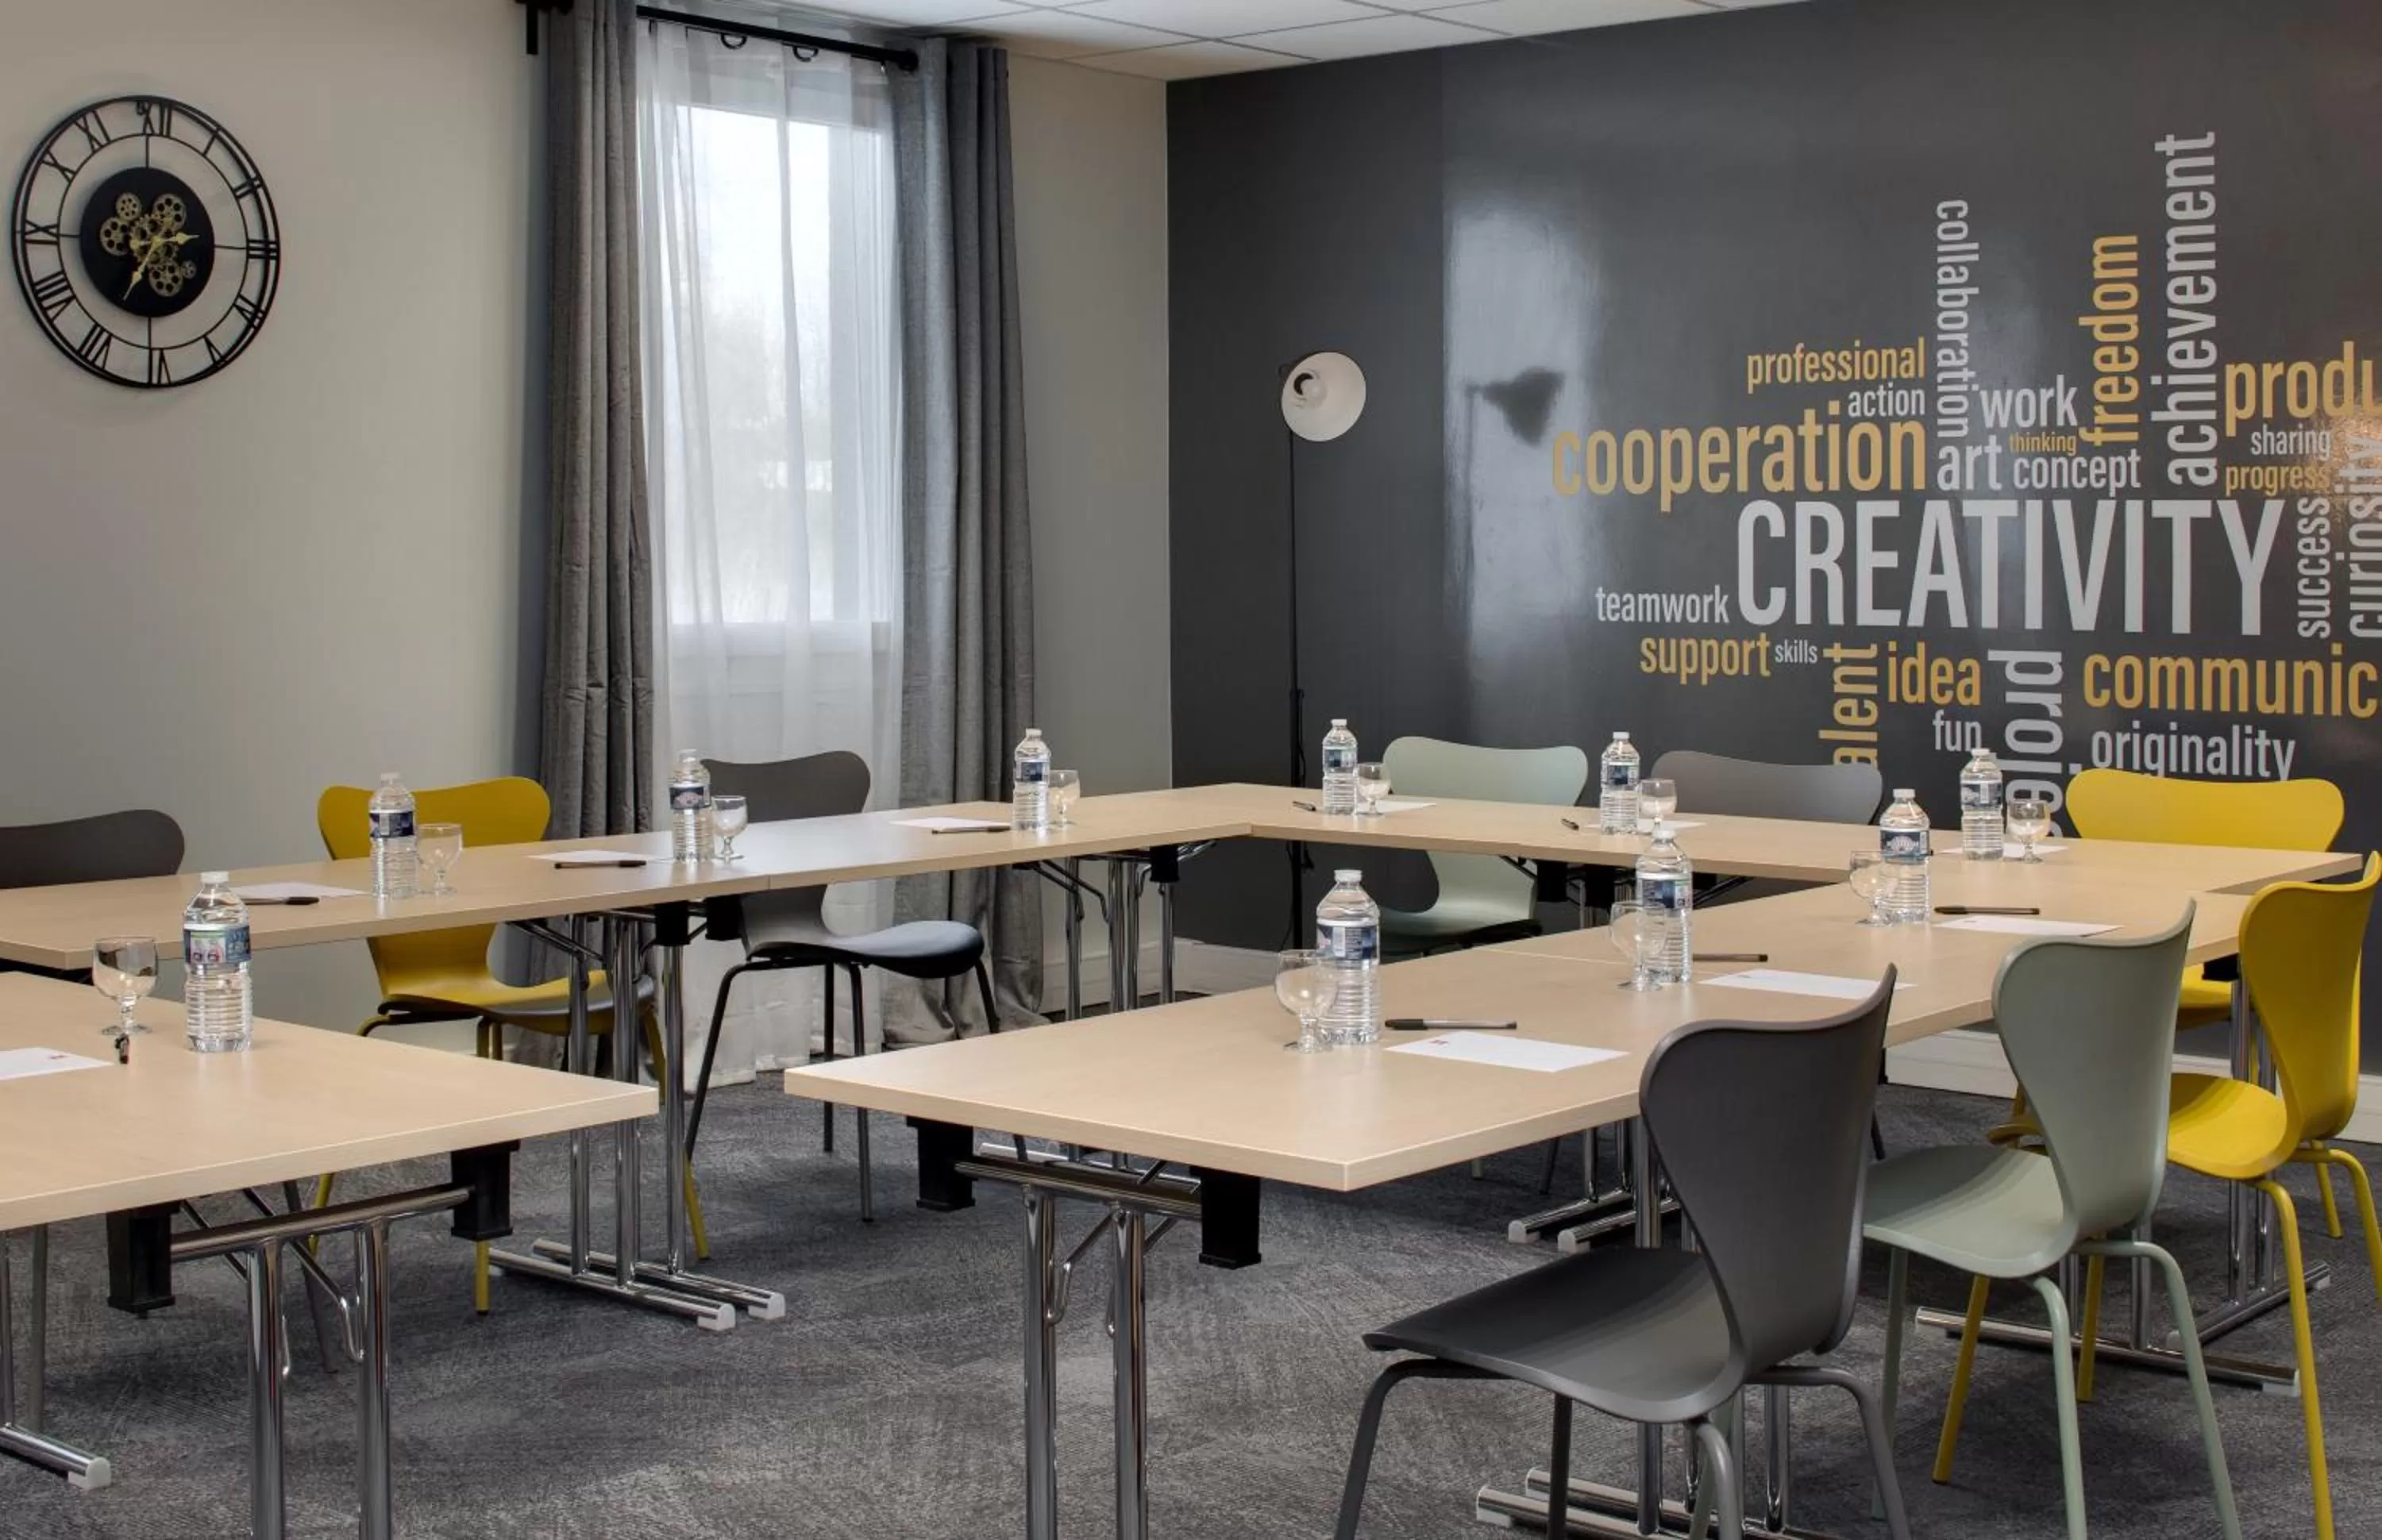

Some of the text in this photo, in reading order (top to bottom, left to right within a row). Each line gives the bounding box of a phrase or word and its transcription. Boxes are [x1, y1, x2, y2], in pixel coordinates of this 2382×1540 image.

[1937, 199, 1979, 438] collaboration
[2151, 131, 2218, 486] achievement
[1748, 337, 1925, 394] professional
[2079, 235, 2139, 445] freedom
[1848, 383, 1925, 417] action
[1980, 375, 2078, 429] work
[1552, 401, 1925, 514] cooperation
[1937, 433, 2002, 492] art
[2010, 431, 2076, 457] thinking
[2250, 422, 2332, 461] sharing
[2013, 448, 2141, 498] concept
[2226, 465, 2331, 497] progress
[1738, 499, 2284, 636] CREATIVITY
[2297, 496, 2331, 639] success
[1596, 584, 1729, 624] teamwork
[1640, 633, 1771, 685] support
[1775, 640, 1817, 664] skills
[1887, 641, 1982, 706] idea
[2083, 643, 2378, 718] communic
[1818, 642, 1879, 772] alent
[1933, 709, 1982, 752] fun
[2091, 720, 2297, 782] originality
